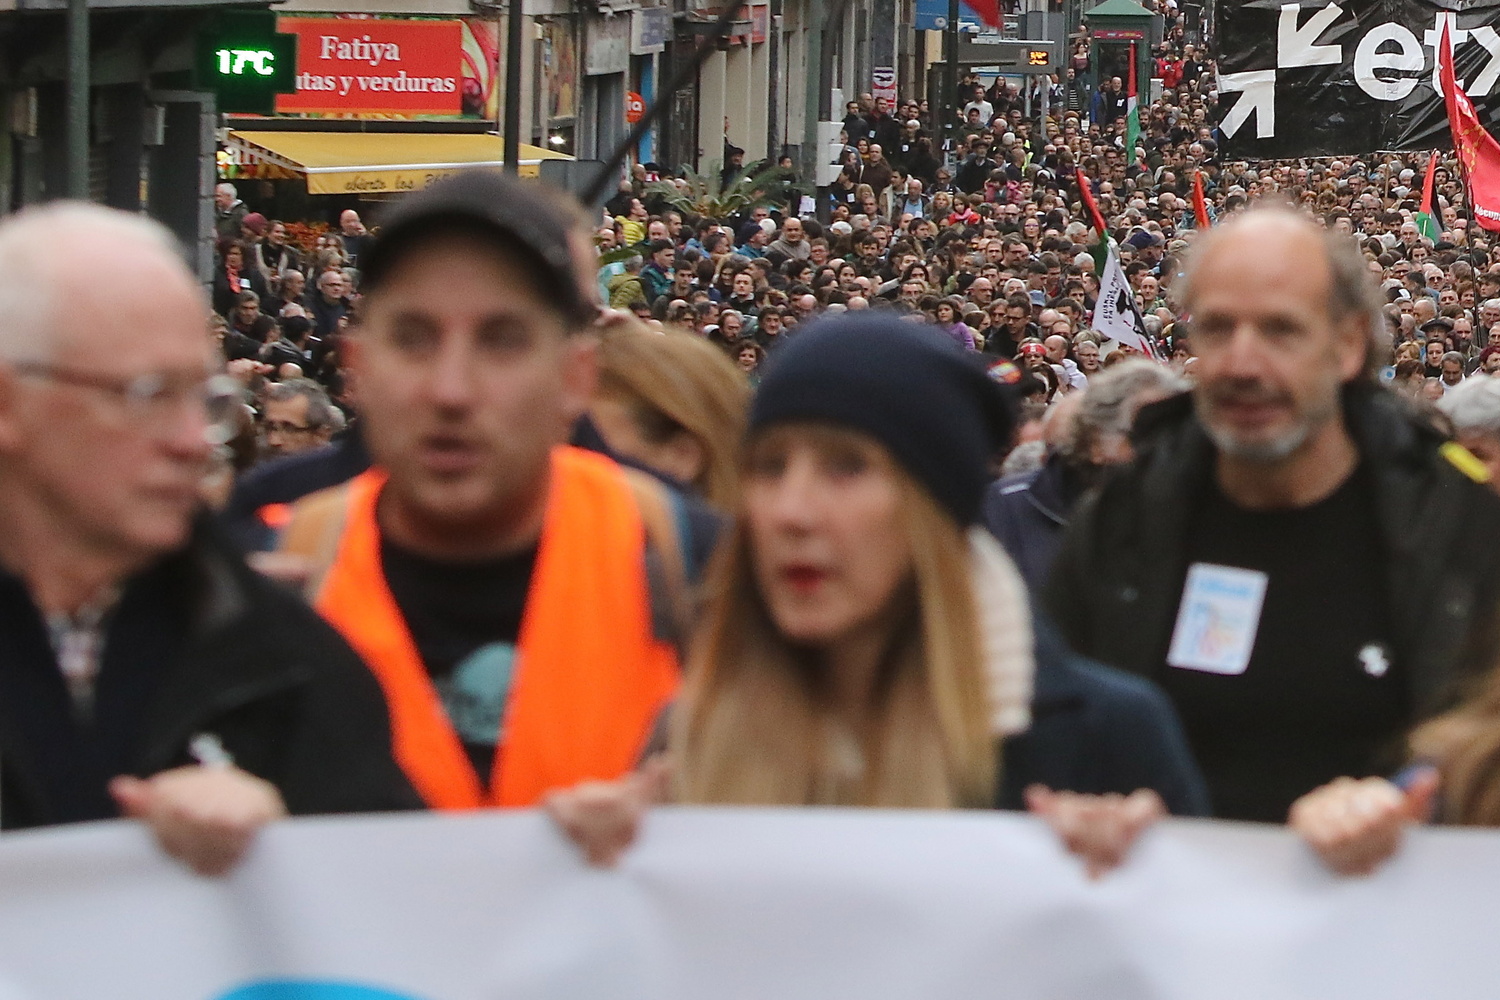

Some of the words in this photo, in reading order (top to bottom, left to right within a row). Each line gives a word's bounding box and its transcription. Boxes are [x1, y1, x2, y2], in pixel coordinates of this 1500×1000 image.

[320, 35, 400, 66] Fatiya
[338, 75, 354, 96] y
[355, 71, 456, 93] verduras
